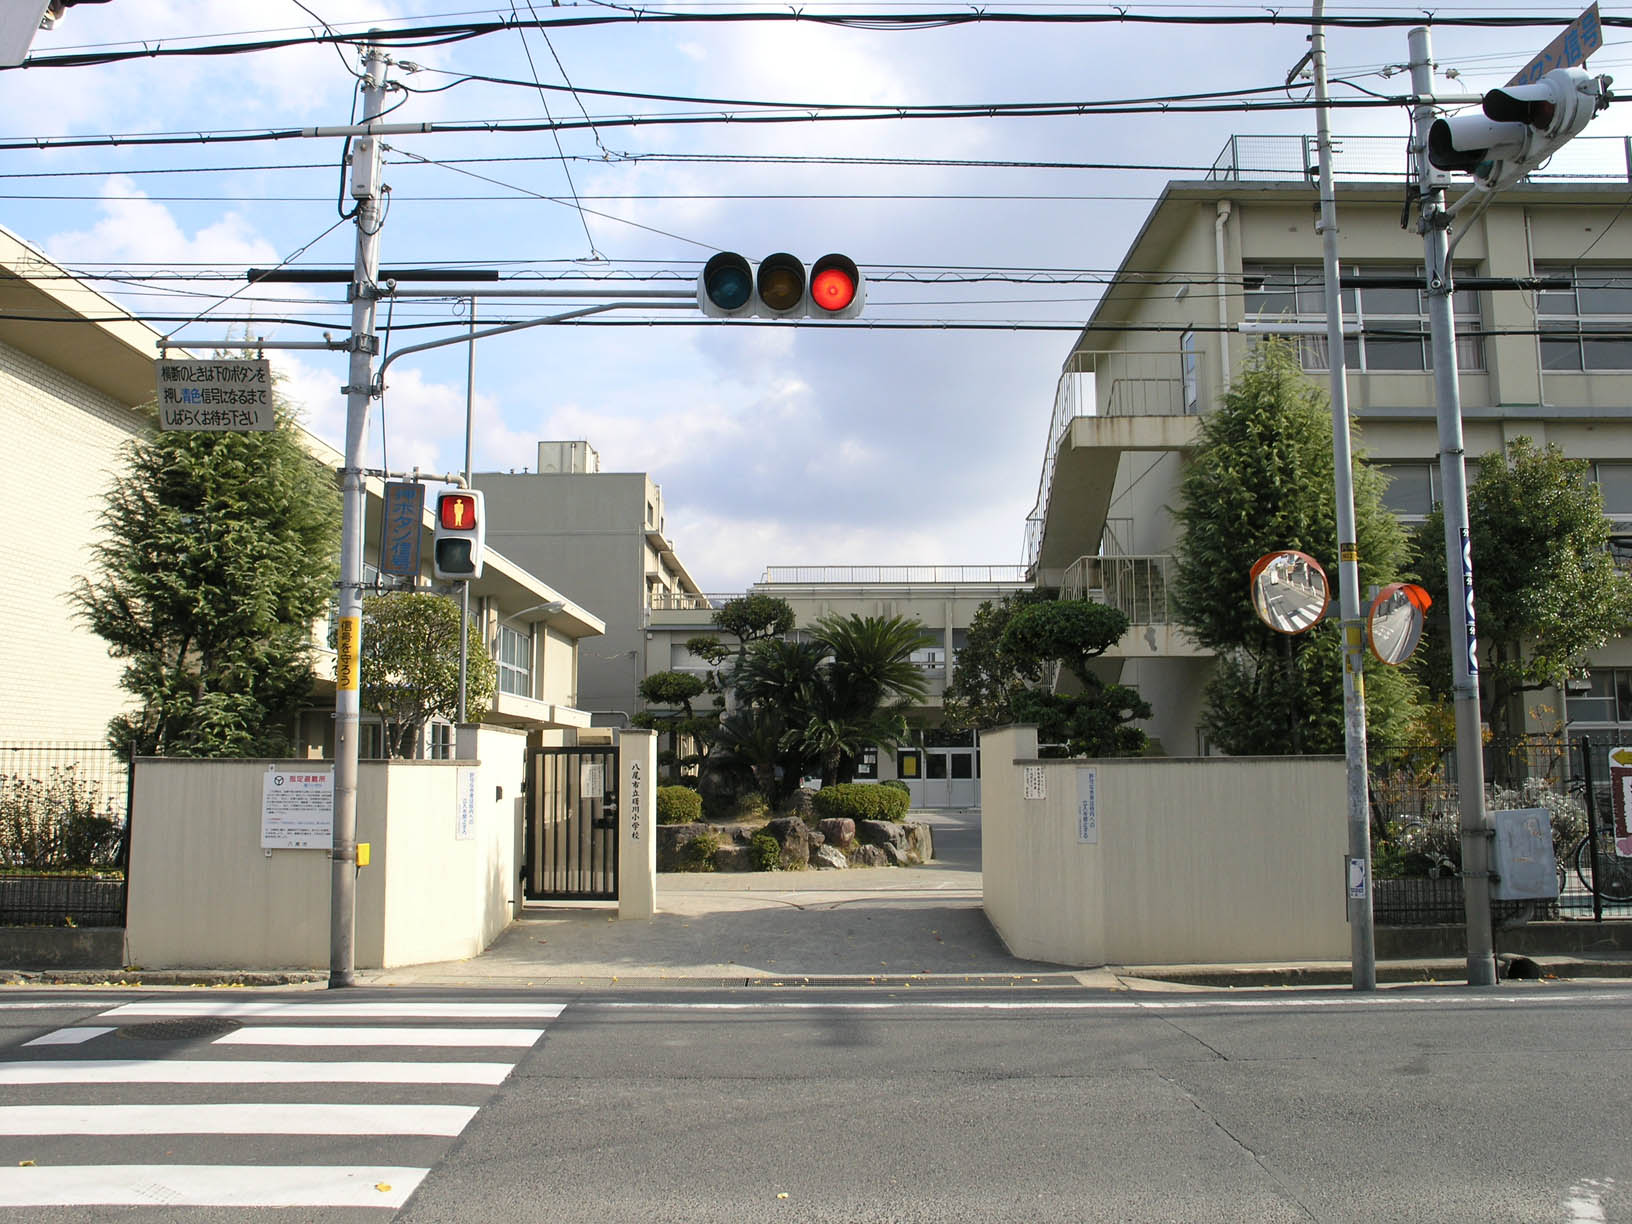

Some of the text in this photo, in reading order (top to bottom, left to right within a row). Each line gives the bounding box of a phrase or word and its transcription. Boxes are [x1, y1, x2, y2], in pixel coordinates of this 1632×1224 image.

[161, 365, 266, 383] 横断のときは下のボタンを
[163, 387, 268, 405] 押し青色信号になるまで
[165, 409, 259, 427] しばらくお待ち下さい
